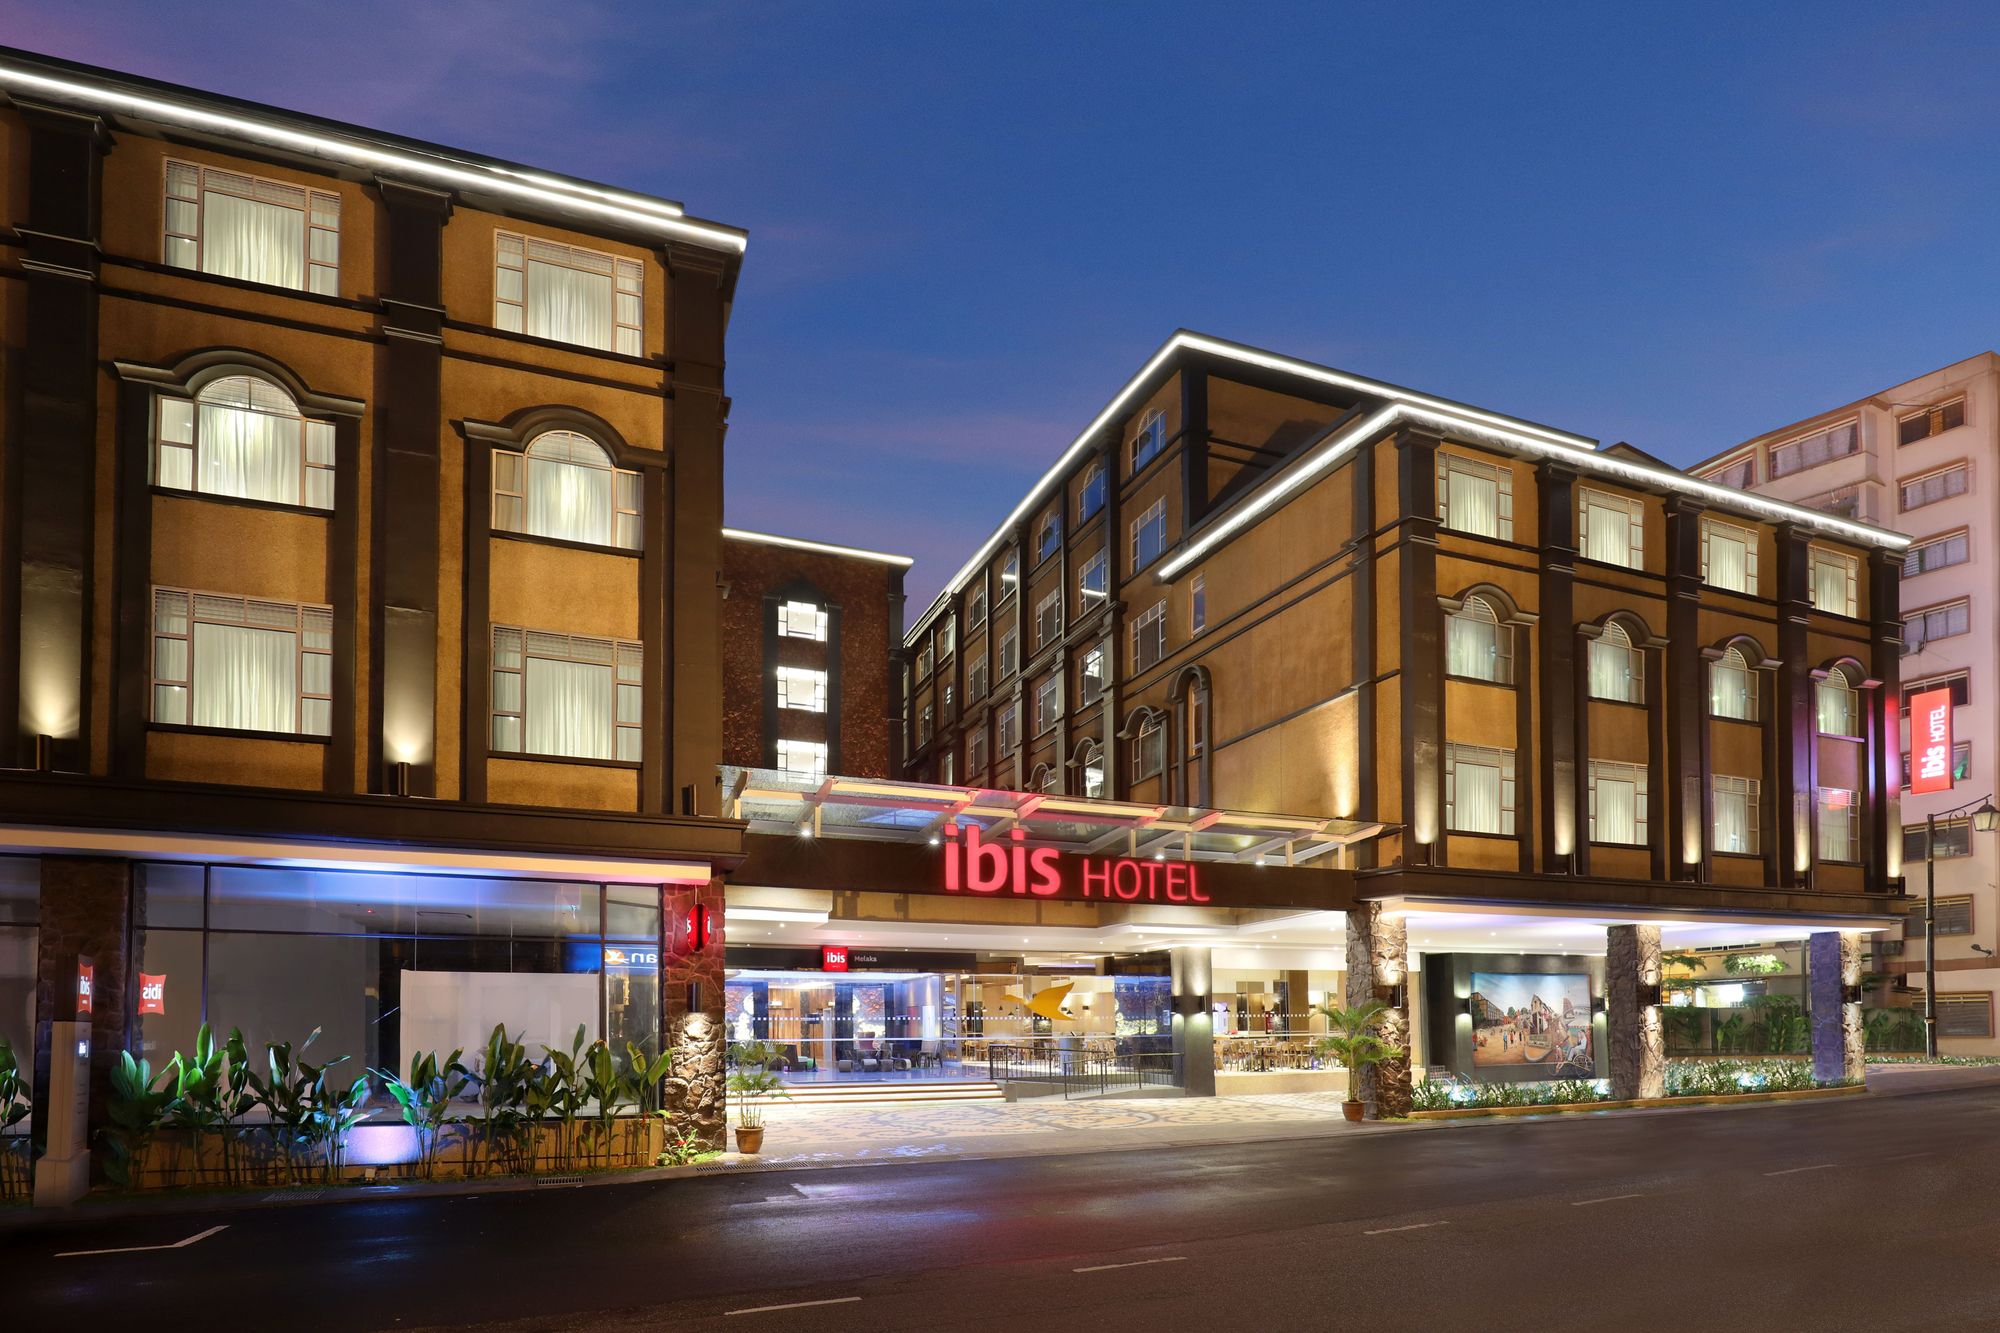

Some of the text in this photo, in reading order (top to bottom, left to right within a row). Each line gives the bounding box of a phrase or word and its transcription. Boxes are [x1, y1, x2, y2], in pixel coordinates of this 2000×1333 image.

[1921, 704, 1946, 779] ibis HOTEL
[944, 824, 1210, 902] ibis HOTEL
[826, 952, 846, 964] ibis
[854, 955, 878, 963] Melaka
[80, 975, 90, 995] ibis
